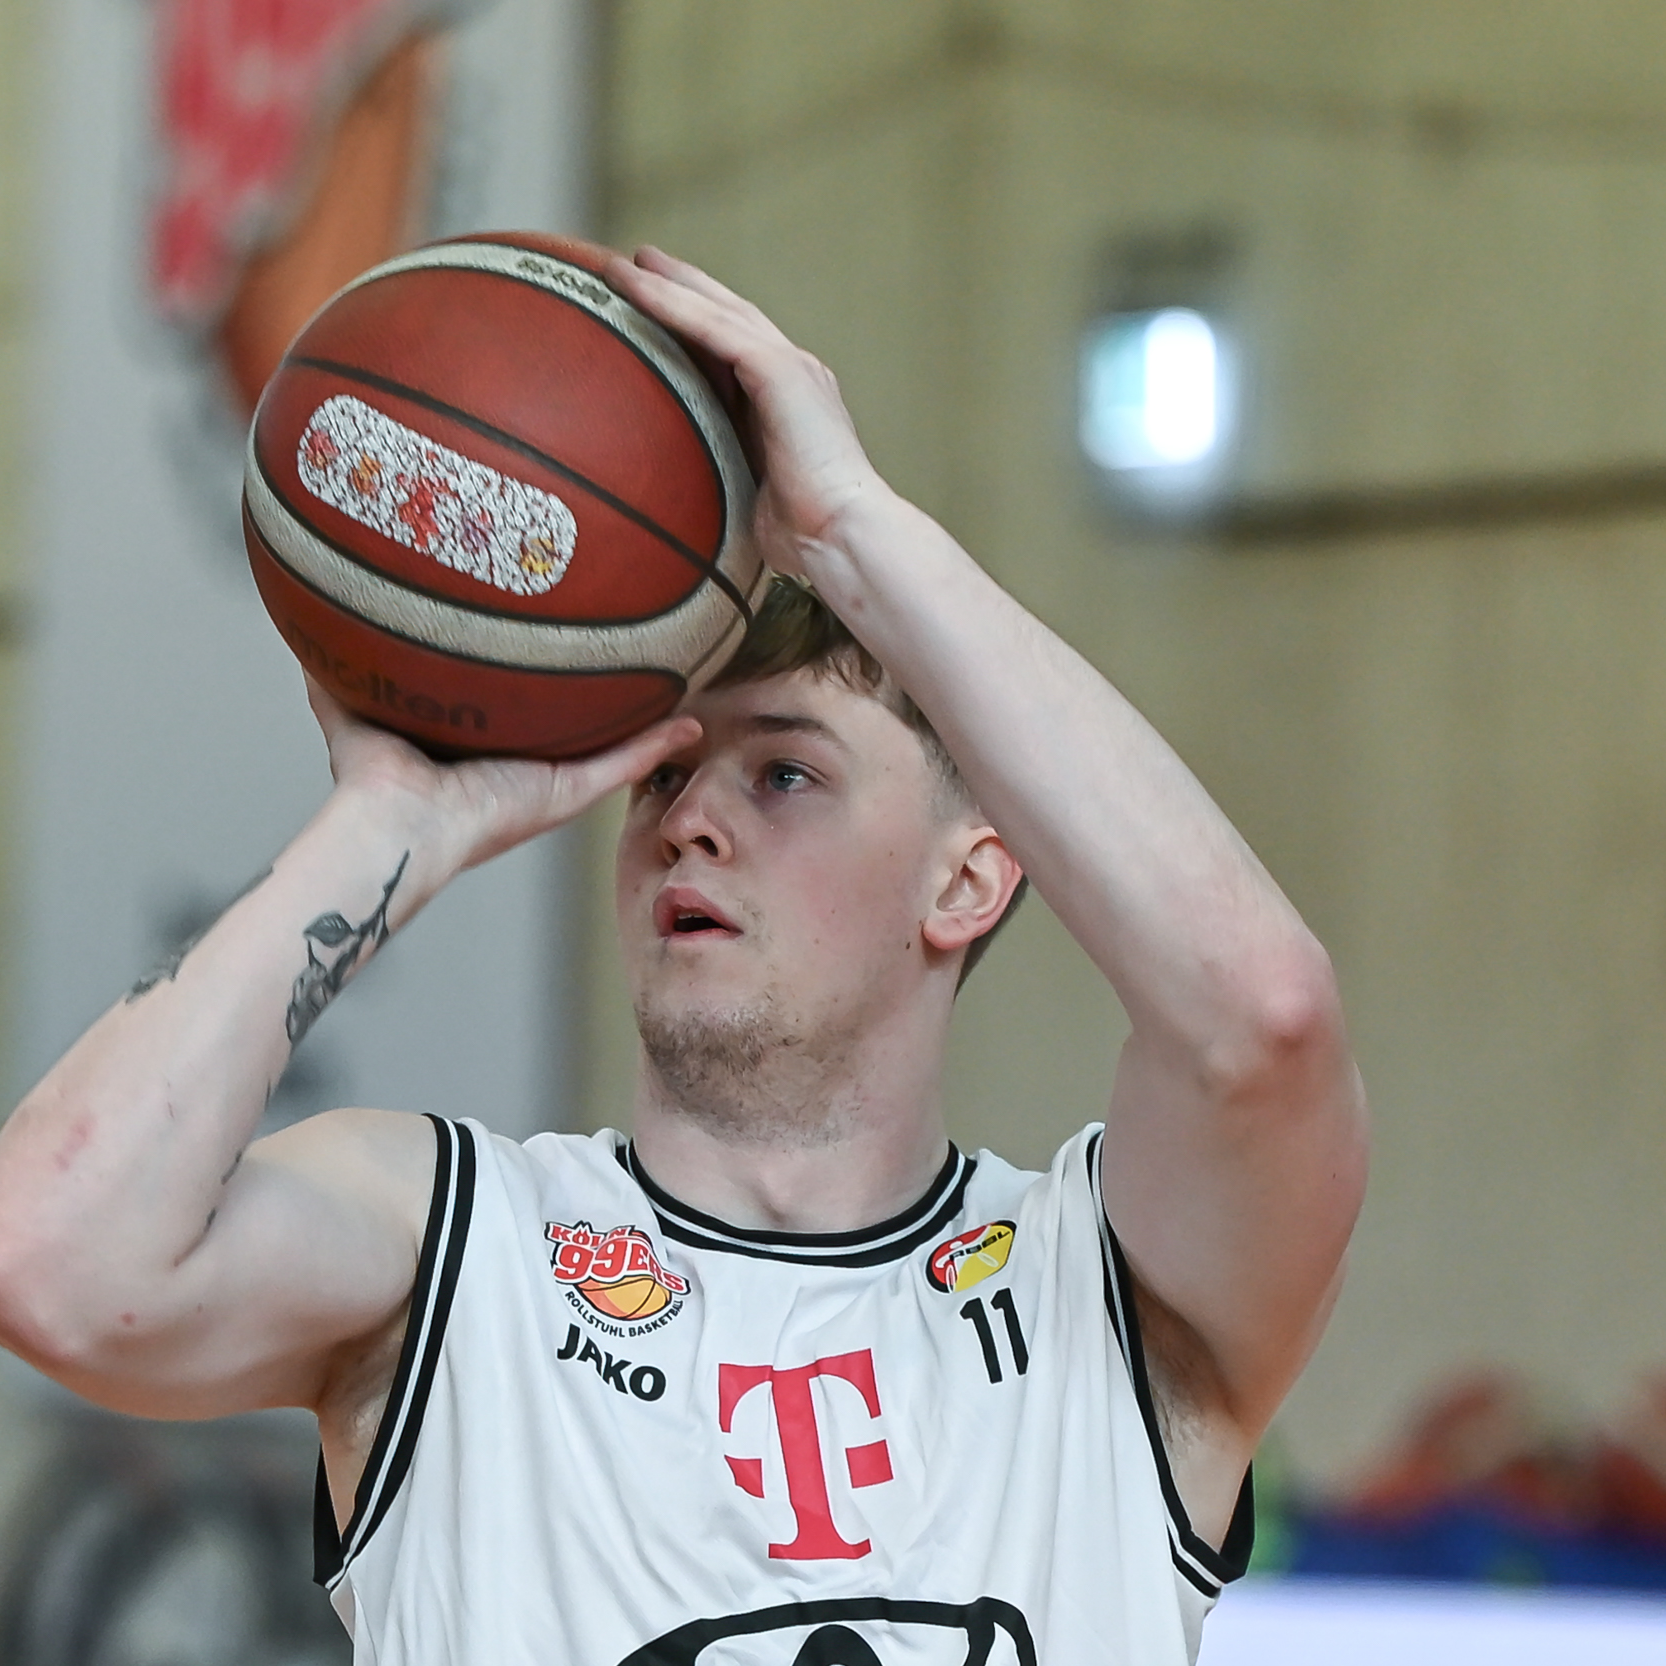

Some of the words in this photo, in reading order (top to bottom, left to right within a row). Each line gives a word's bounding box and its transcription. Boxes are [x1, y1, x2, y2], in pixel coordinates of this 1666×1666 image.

[551, 1225, 627, 1250] KÖLN
[554, 1238, 685, 1292] 99ERS
[565, 1291, 625, 1338] ROLLSTUHL
[628, 1299, 683, 1337] BASKETBALL
[959, 1287, 1029, 1384] 11
[556, 1323, 667, 1401] JAKO
